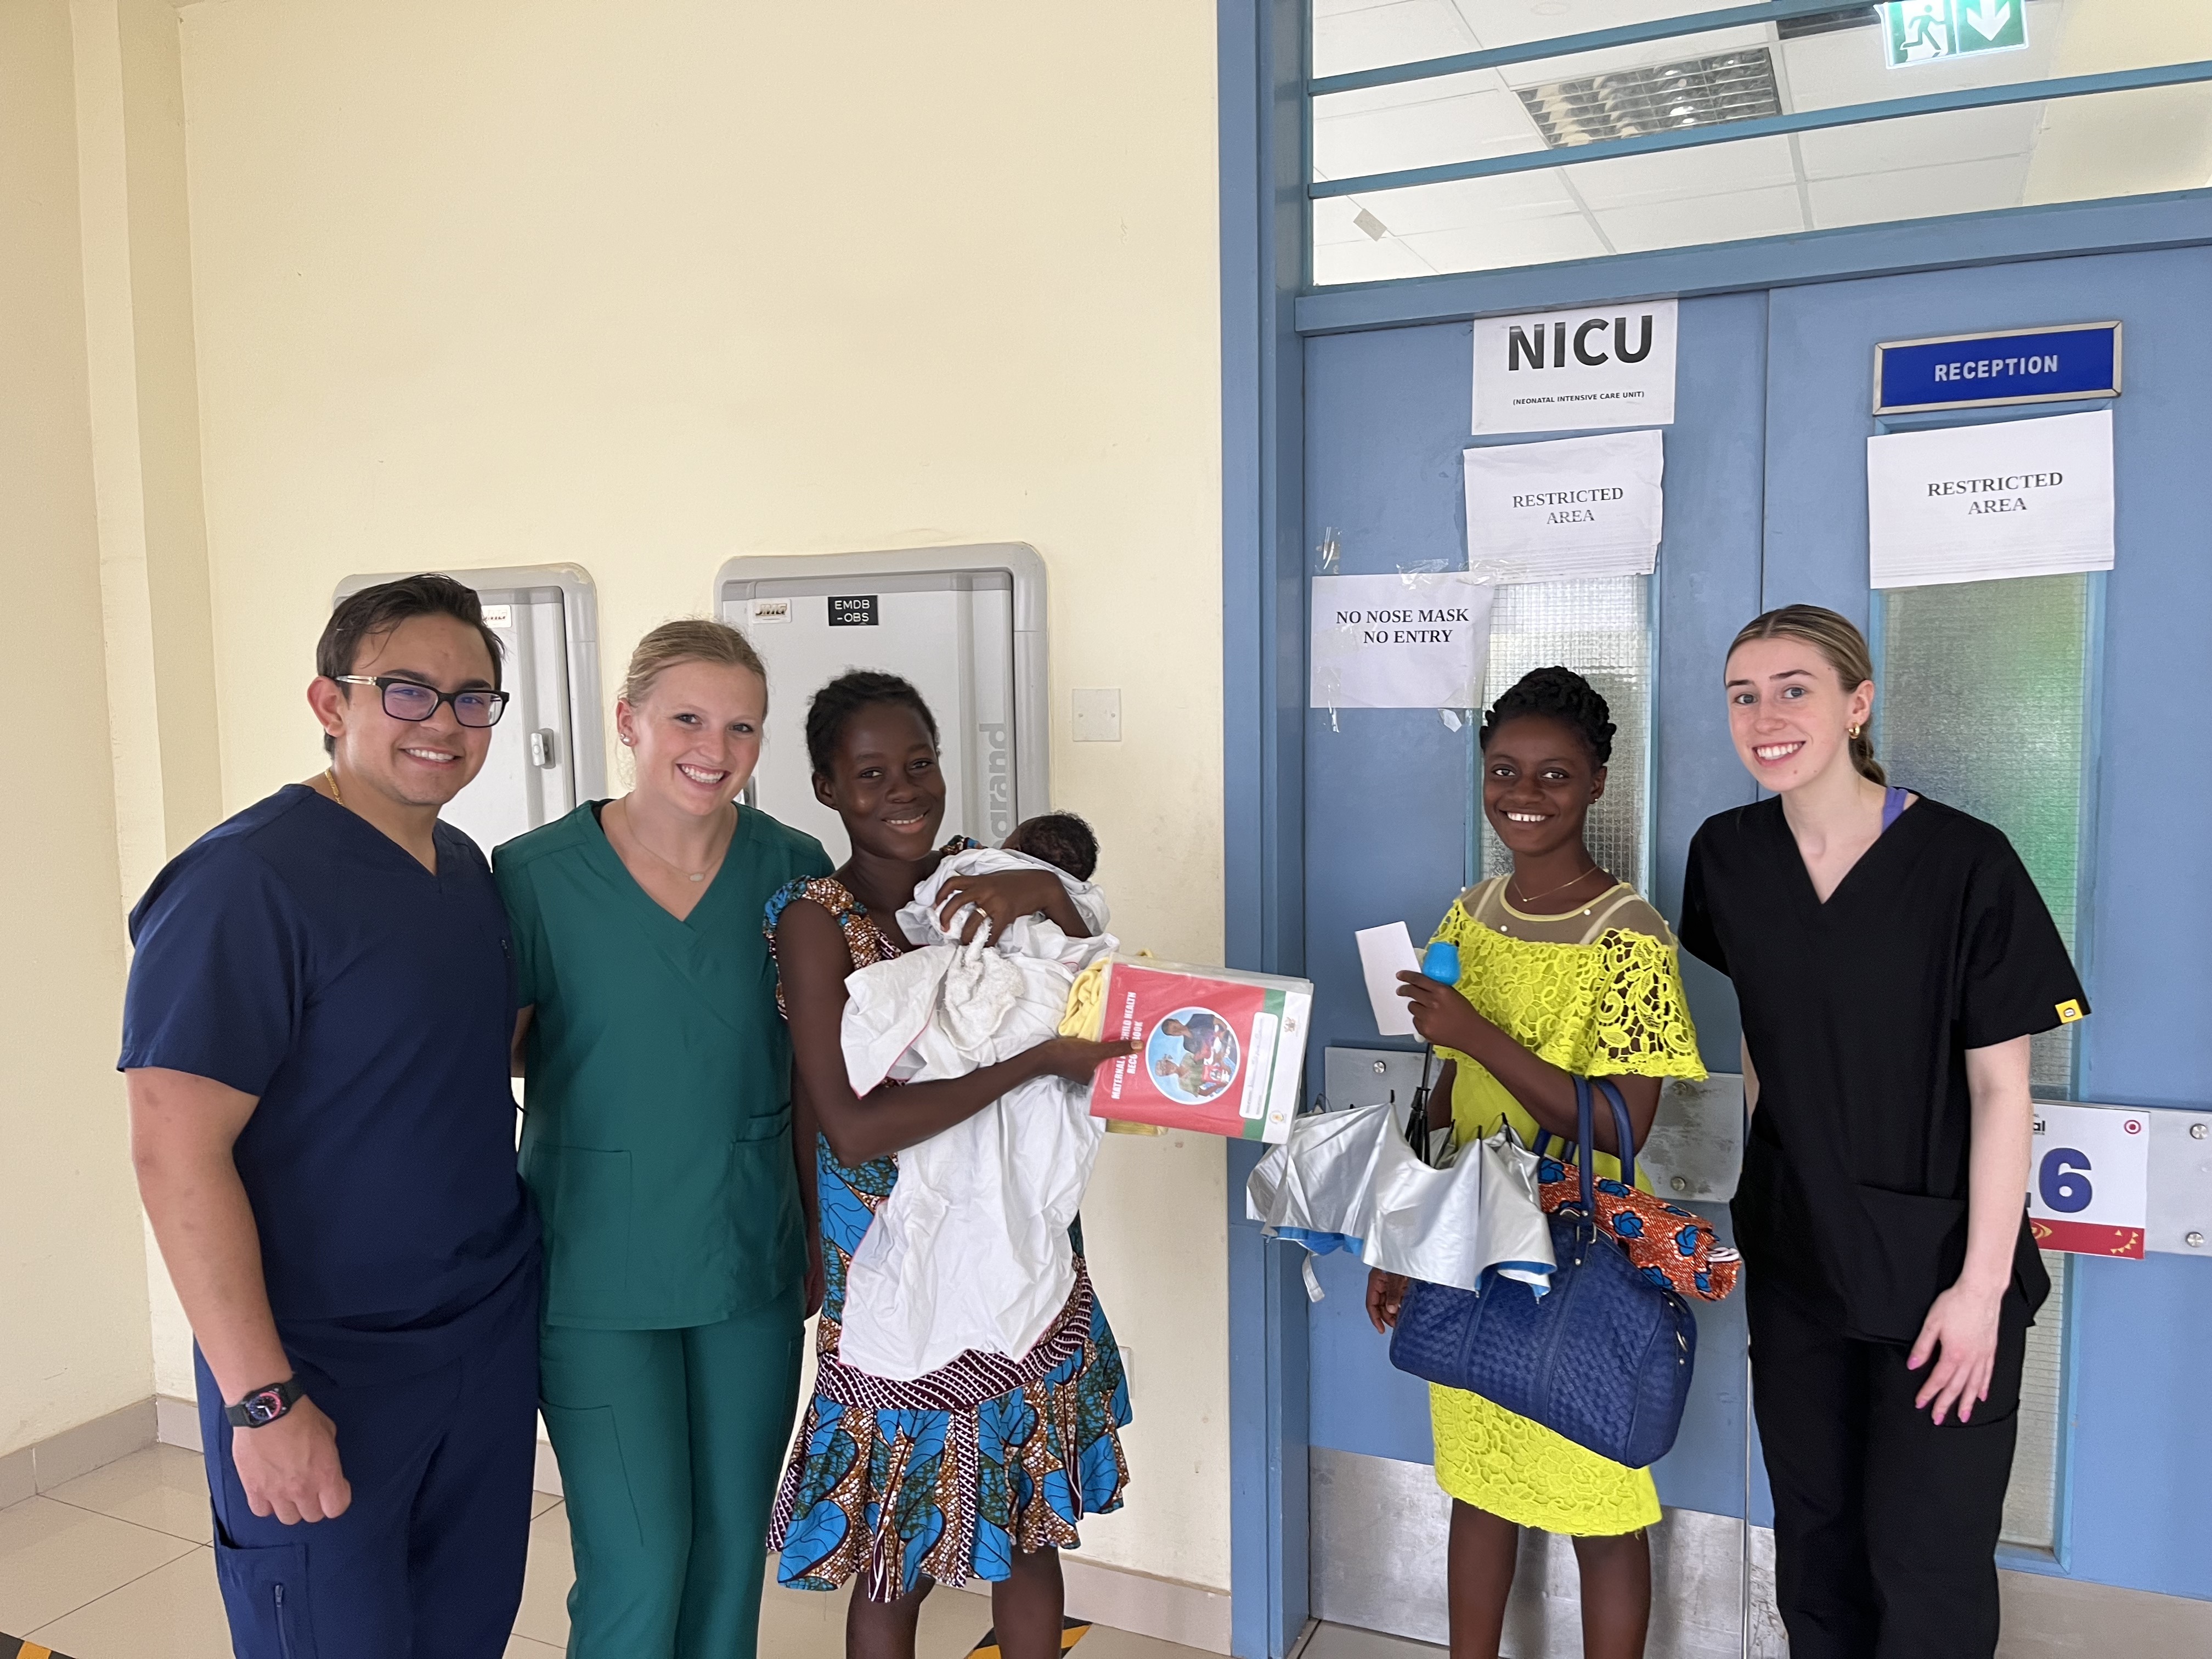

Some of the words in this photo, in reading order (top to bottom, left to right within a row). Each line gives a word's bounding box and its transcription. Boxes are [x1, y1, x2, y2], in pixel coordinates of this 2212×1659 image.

[1508, 315, 1653, 372] NICU
[1934, 354, 2058, 382] RECEPTION
[1513, 396, 1555, 406] (NEONATAL
[1557, 394, 1598, 403] INTENSIVE
[1927, 472, 2064, 497] RESTRICTED
[1513, 487, 1624, 509] RESTRICTED
[1967, 497, 2028, 516] AREA
[1547, 509, 1595, 525] AREA
[834, 600, 871, 610] EMDB
[837, 613, 870, 623] -OBS
[1336, 611, 1361, 624] NO
[1366, 610, 1413, 623] NOSE
[1418, 608, 1469, 622] MASK
[1363, 630, 1389, 644] NO
[1393, 629, 1453, 644] ENTRY
[1111, 1059, 1126, 1099] MATERNAL
[1124, 991, 1136, 1019] HEALTH
[1126, 1053, 1138, 1074] RECO
[2039, 1147, 2092, 1213] 6
